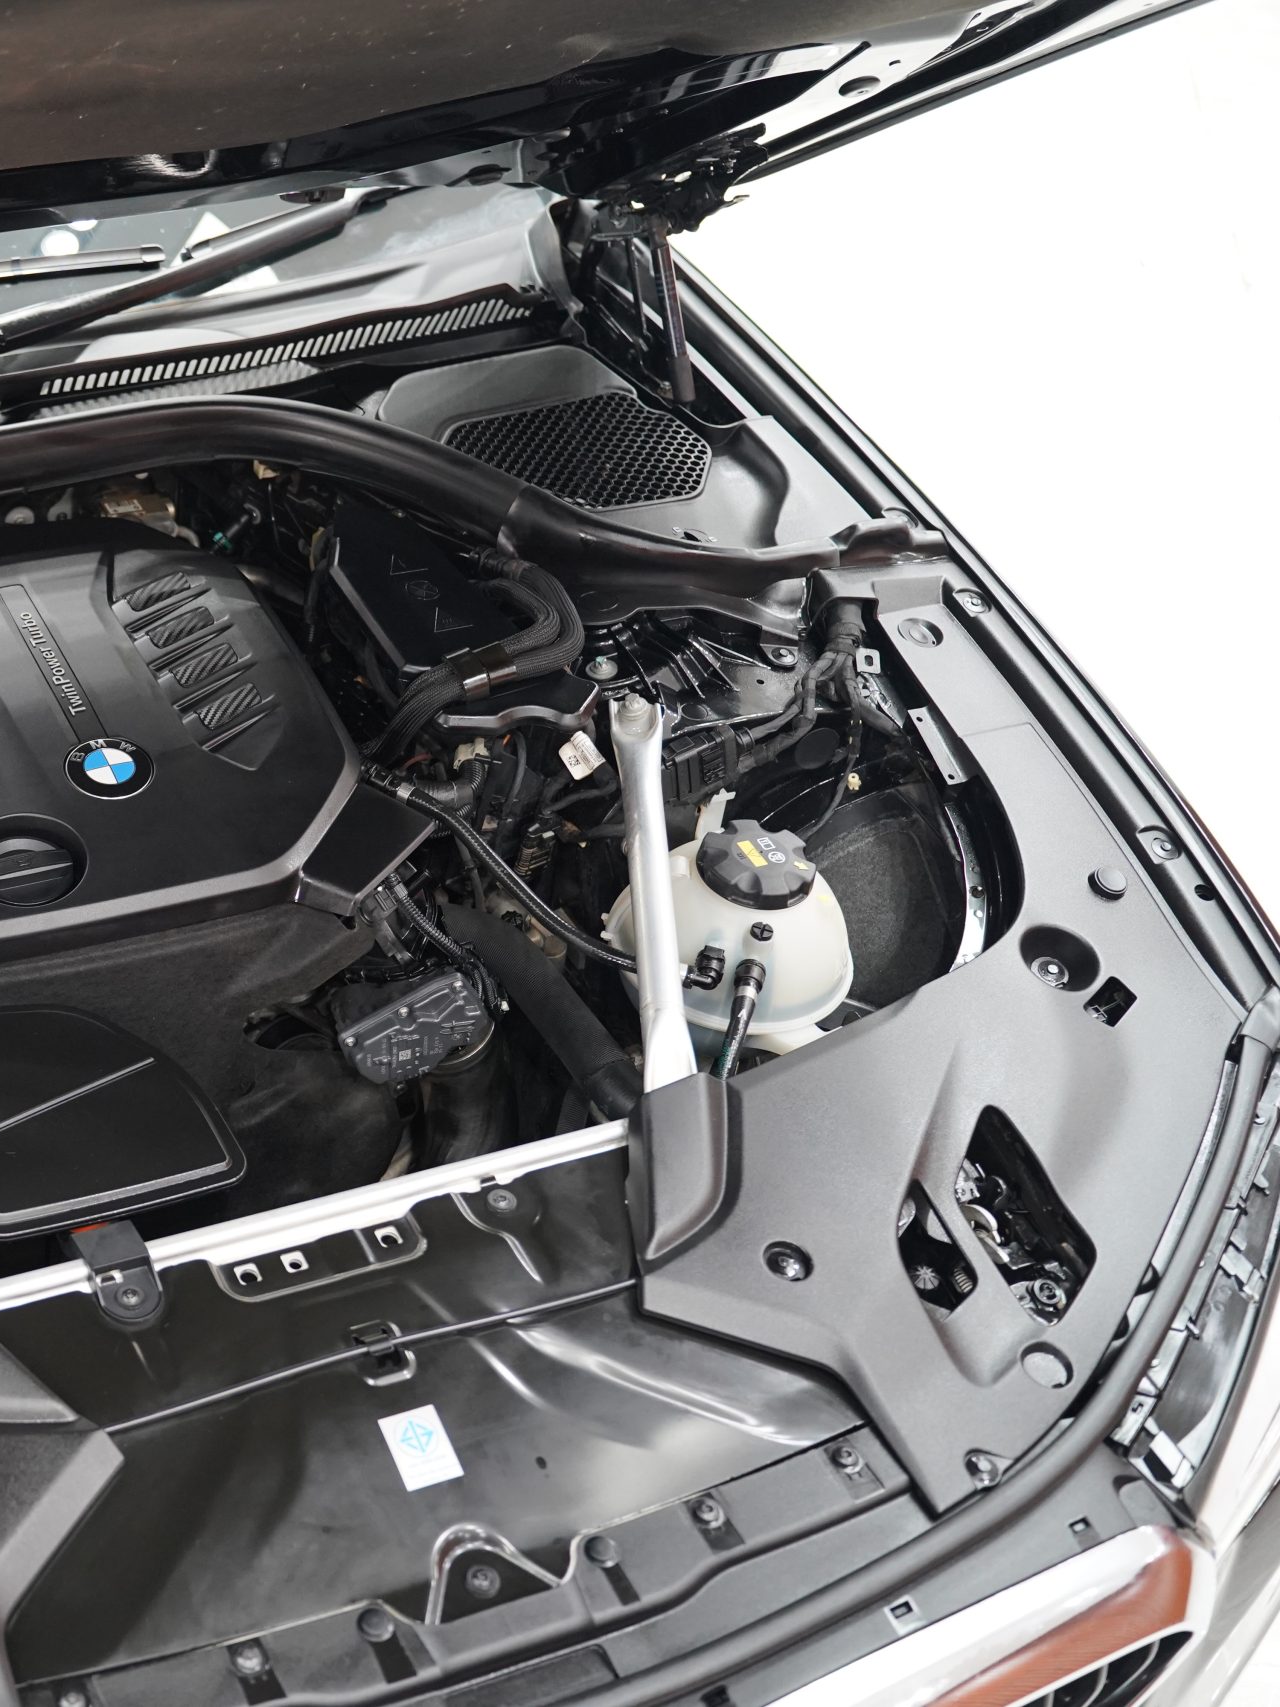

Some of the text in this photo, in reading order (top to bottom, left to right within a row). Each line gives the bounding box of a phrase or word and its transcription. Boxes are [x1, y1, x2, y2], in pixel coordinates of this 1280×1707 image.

[20, 611, 87, 716] TwinPower Turbo
[70, 738, 137, 762] BMW
